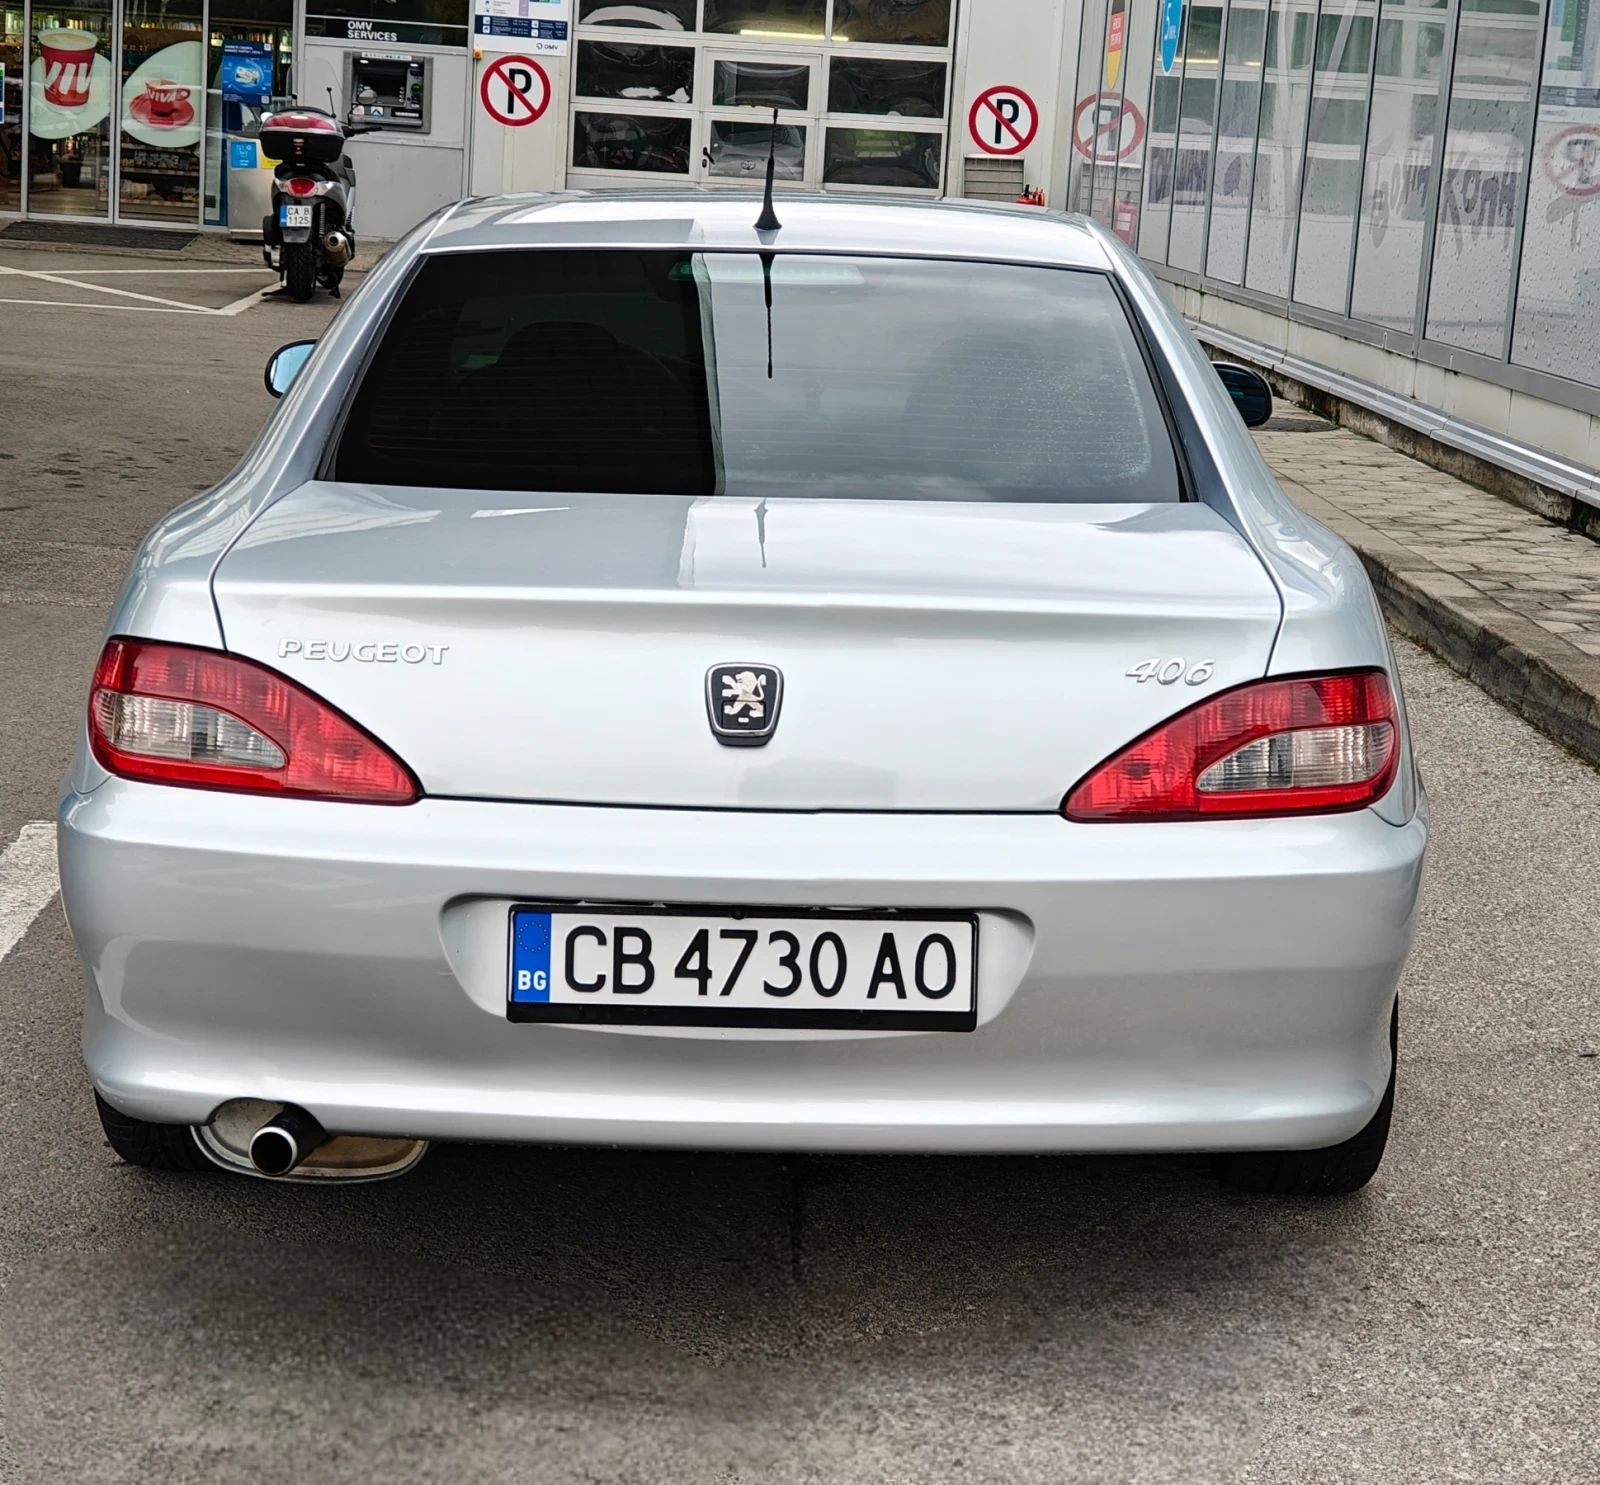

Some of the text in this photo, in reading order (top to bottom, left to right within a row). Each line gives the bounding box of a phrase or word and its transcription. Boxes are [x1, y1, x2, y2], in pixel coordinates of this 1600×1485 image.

[347, 20, 373, 30] OMV
[347, 30, 398, 41] SERVICES
[147, 88, 177, 104] VIVA
[287, 207, 310, 215] CA B
[289, 216, 309, 225] 1125
[278, 638, 450, 665] PEUGEOT
[1125, 657, 1215, 686] 406
[564, 925, 957, 1000] CB 4730 AO
[517, 969, 547, 992] BG
